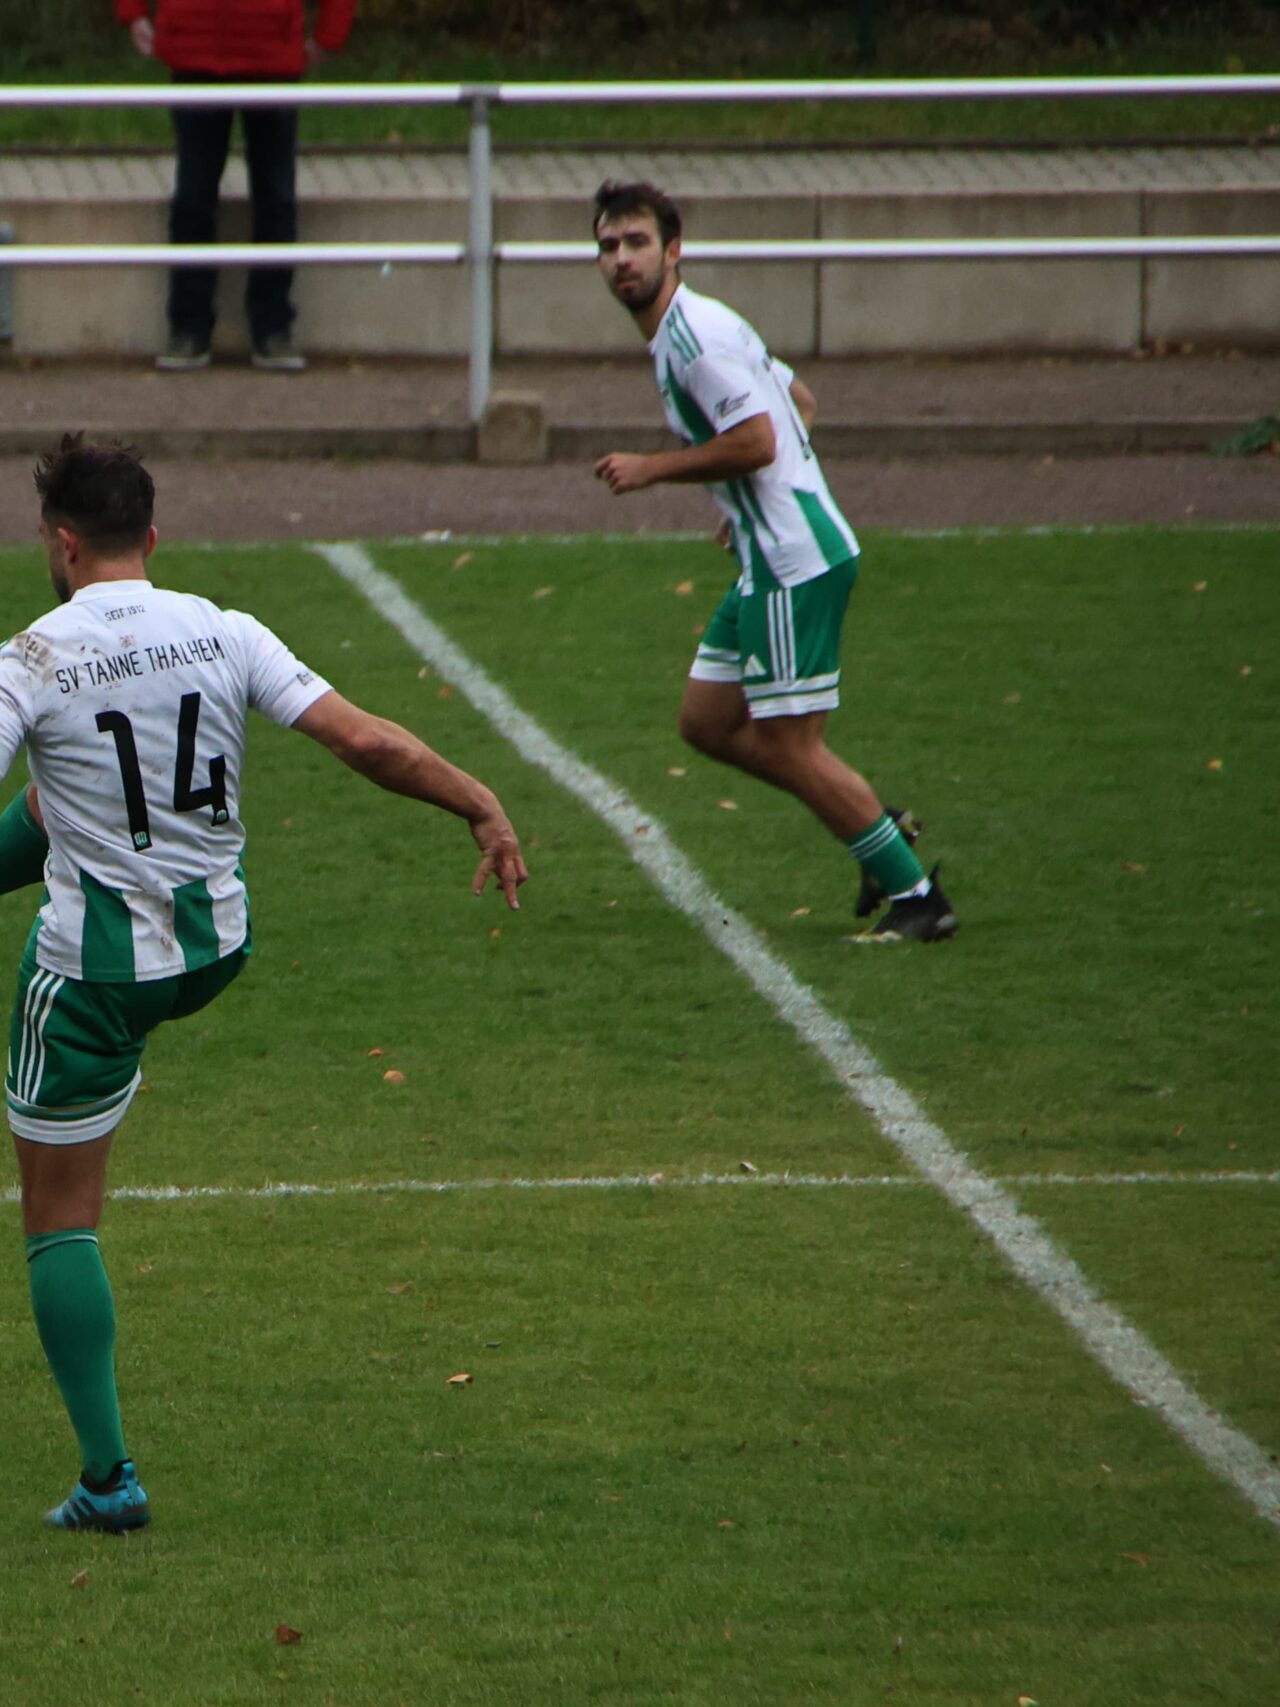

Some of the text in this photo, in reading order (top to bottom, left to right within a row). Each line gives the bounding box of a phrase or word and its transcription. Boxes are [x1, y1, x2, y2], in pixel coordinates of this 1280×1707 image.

[56, 666, 79, 694] SV
[84, 651, 143, 686] TANNE
[95, 692, 229, 851] 14
